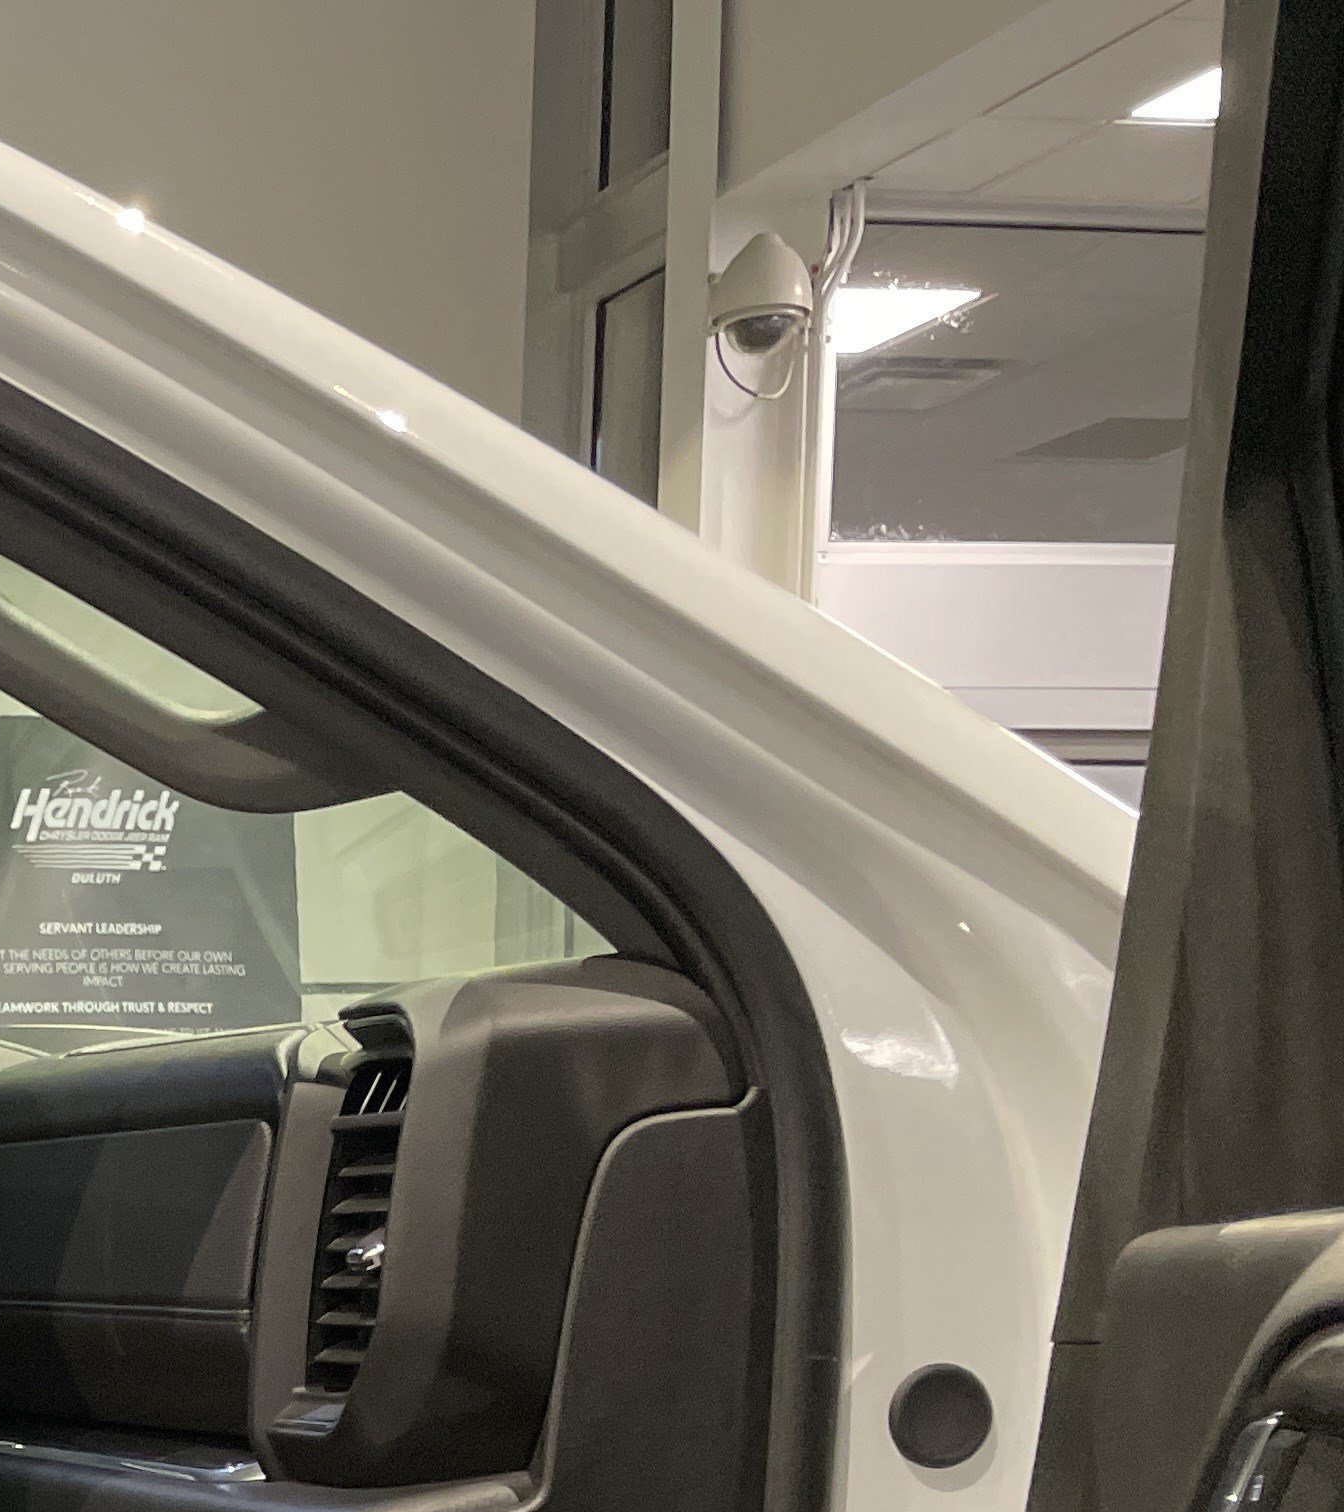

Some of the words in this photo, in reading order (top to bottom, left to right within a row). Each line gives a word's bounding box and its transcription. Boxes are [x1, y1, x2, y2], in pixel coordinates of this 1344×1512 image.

[10, 788, 180, 843] Hendrick
[71, 872, 121, 884] DULUTH
[39, 922, 93, 935] SERVANT
[95, 922, 162, 935] LEADERSHIP
[8, 948, 29, 960] THE
[32, 948, 69, 960] NEEDS
[71, 948, 87, 960] OF
[90, 948, 132, 961] OTHERS
[134, 949, 175, 961] BEFORE
[177, 950, 201, 962] OUR
[203, 951, 233, 963] OWN
[3, 962, 53, 974] SERVING
[56, 962, 96, 974] PEOPLE
[99, 962, 108, 973] IS
[110, 962, 139, 974] HOW
[141, 962, 159, 975] WE
[162, 963, 201, 975] CREATE
[203, 964, 247, 977] LASTING
[61, 1001, 119, 1014] THROUGH
[122, 1001, 155, 1014] TRUST
[157, 1002, 165, 1013] &
[168, 1002, 214, 1015] RESPECT
